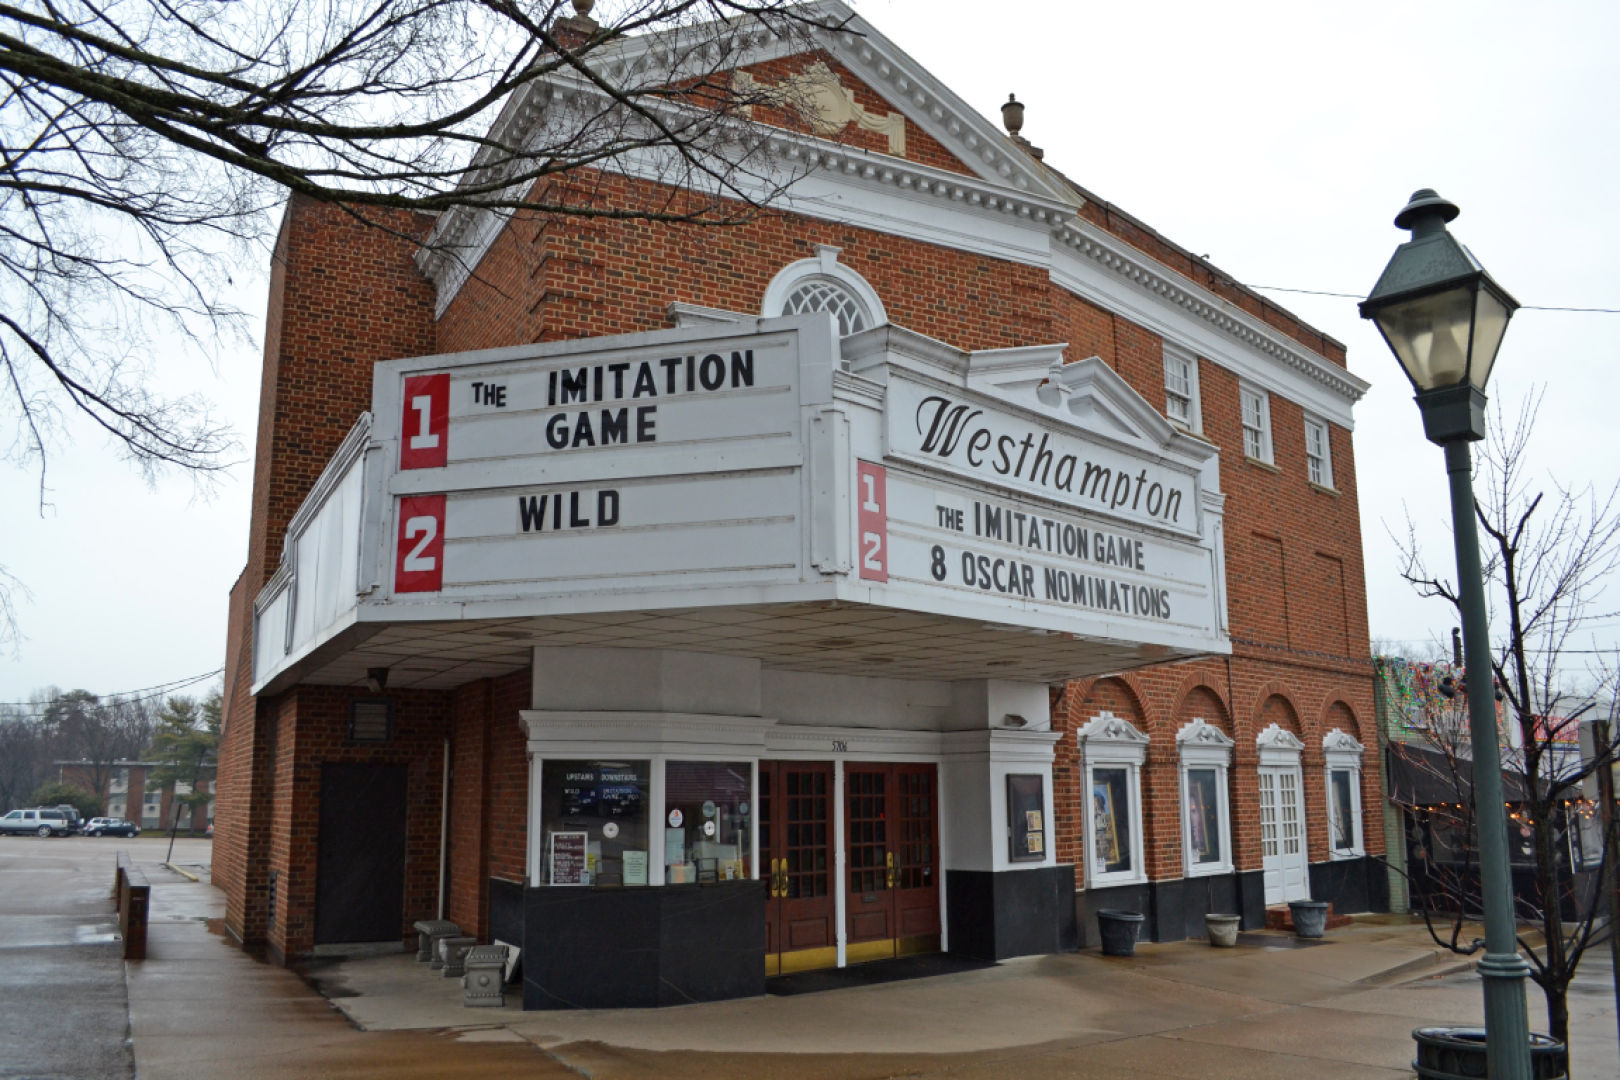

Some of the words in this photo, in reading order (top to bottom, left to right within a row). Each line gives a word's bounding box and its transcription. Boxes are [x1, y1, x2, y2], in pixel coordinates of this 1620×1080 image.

[471, 381, 507, 408] THE
[548, 350, 755, 406] IMITATION
[410, 395, 439, 450] 1
[546, 406, 657, 450] GAME
[916, 396, 1183, 524] Westhampton
[519, 490, 620, 533] WILD
[863, 474, 880, 513] 1
[403, 515, 438, 572] 2
[863, 532, 882, 570] 2
[936, 504, 964, 532] THE
[974, 501, 1089, 562] IMITATION
[1094, 532, 1145, 571] GAME
[931, 545, 947, 582] 8
[962, 551, 1035, 598] OSCAR
[1044, 568, 1171, 619] NOMINATIONS
